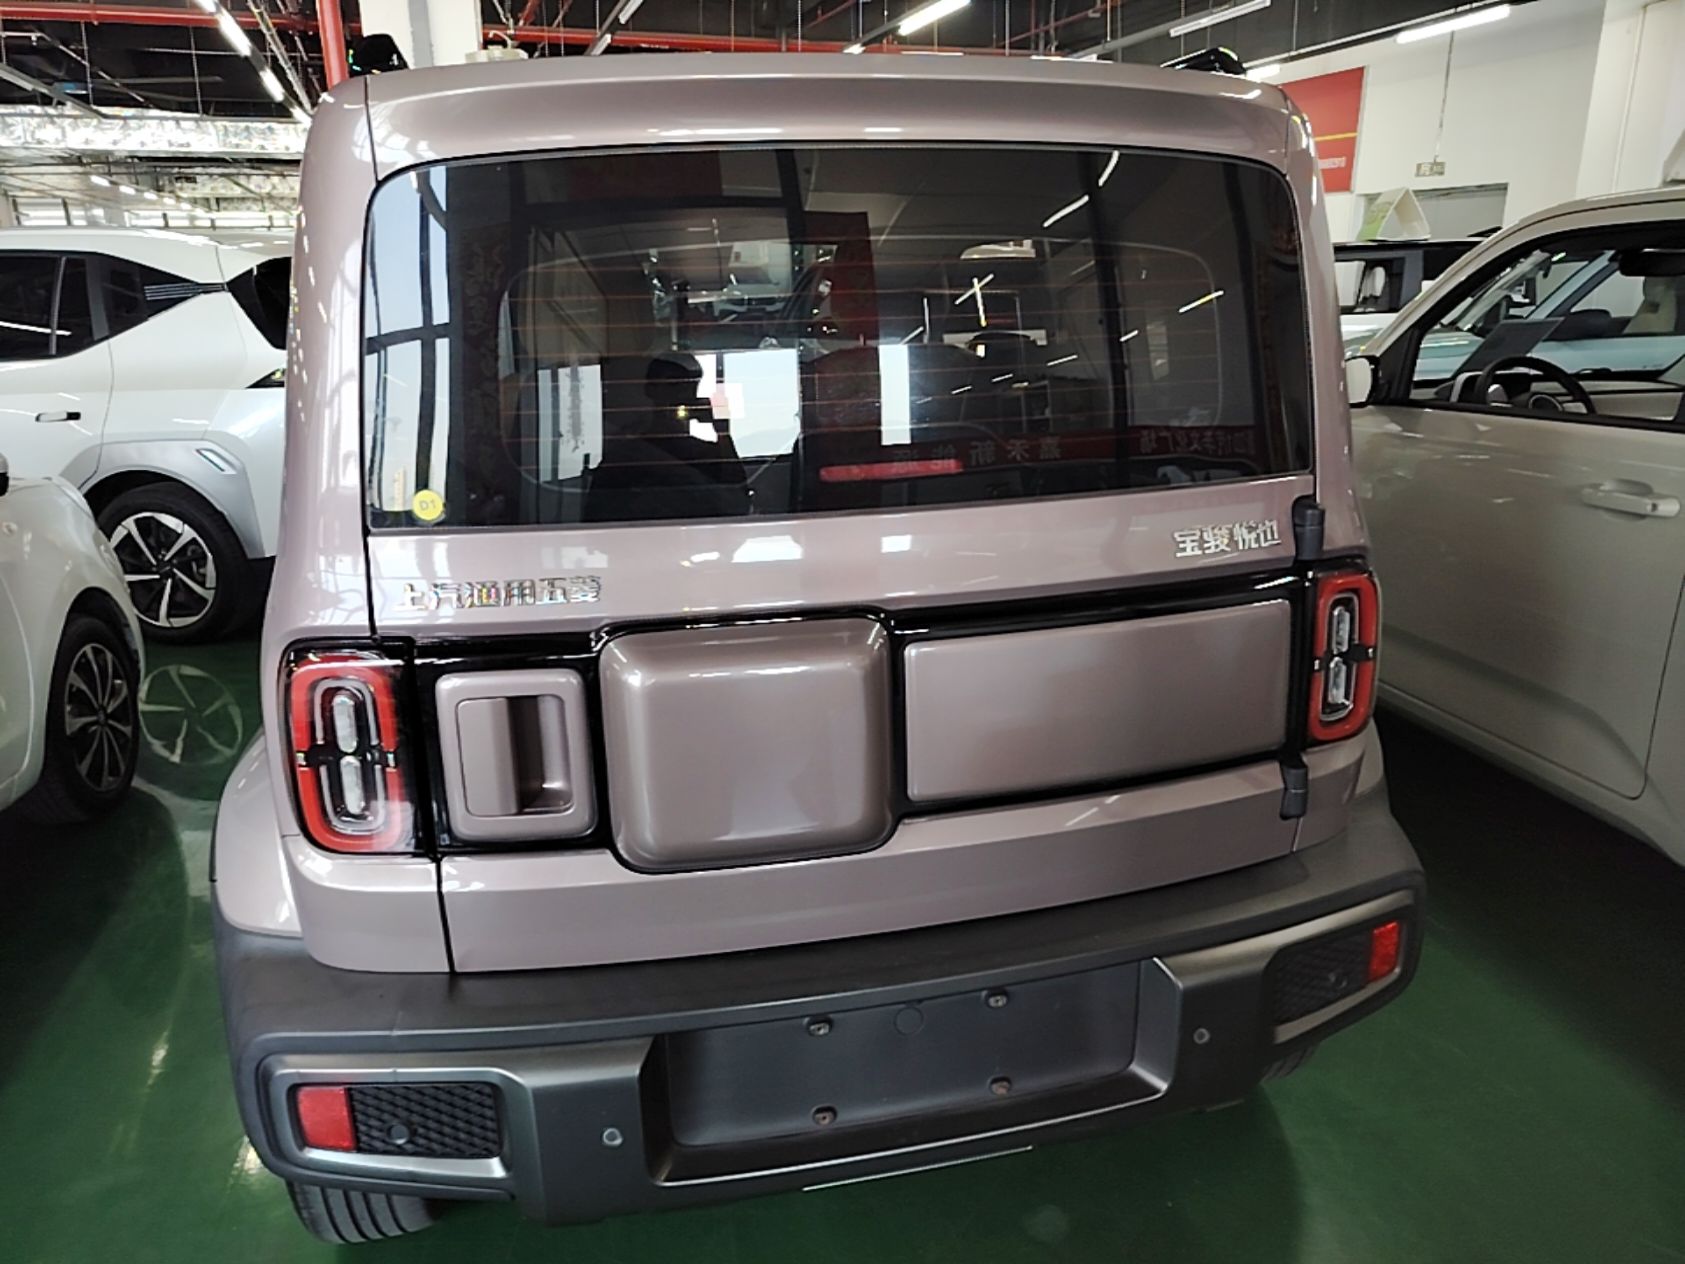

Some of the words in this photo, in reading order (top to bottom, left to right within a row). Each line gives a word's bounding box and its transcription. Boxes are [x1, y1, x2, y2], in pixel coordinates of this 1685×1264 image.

[1173, 520, 1282, 558] 宝骏悦也
[394, 575, 602, 611] 上汽通用五菱
